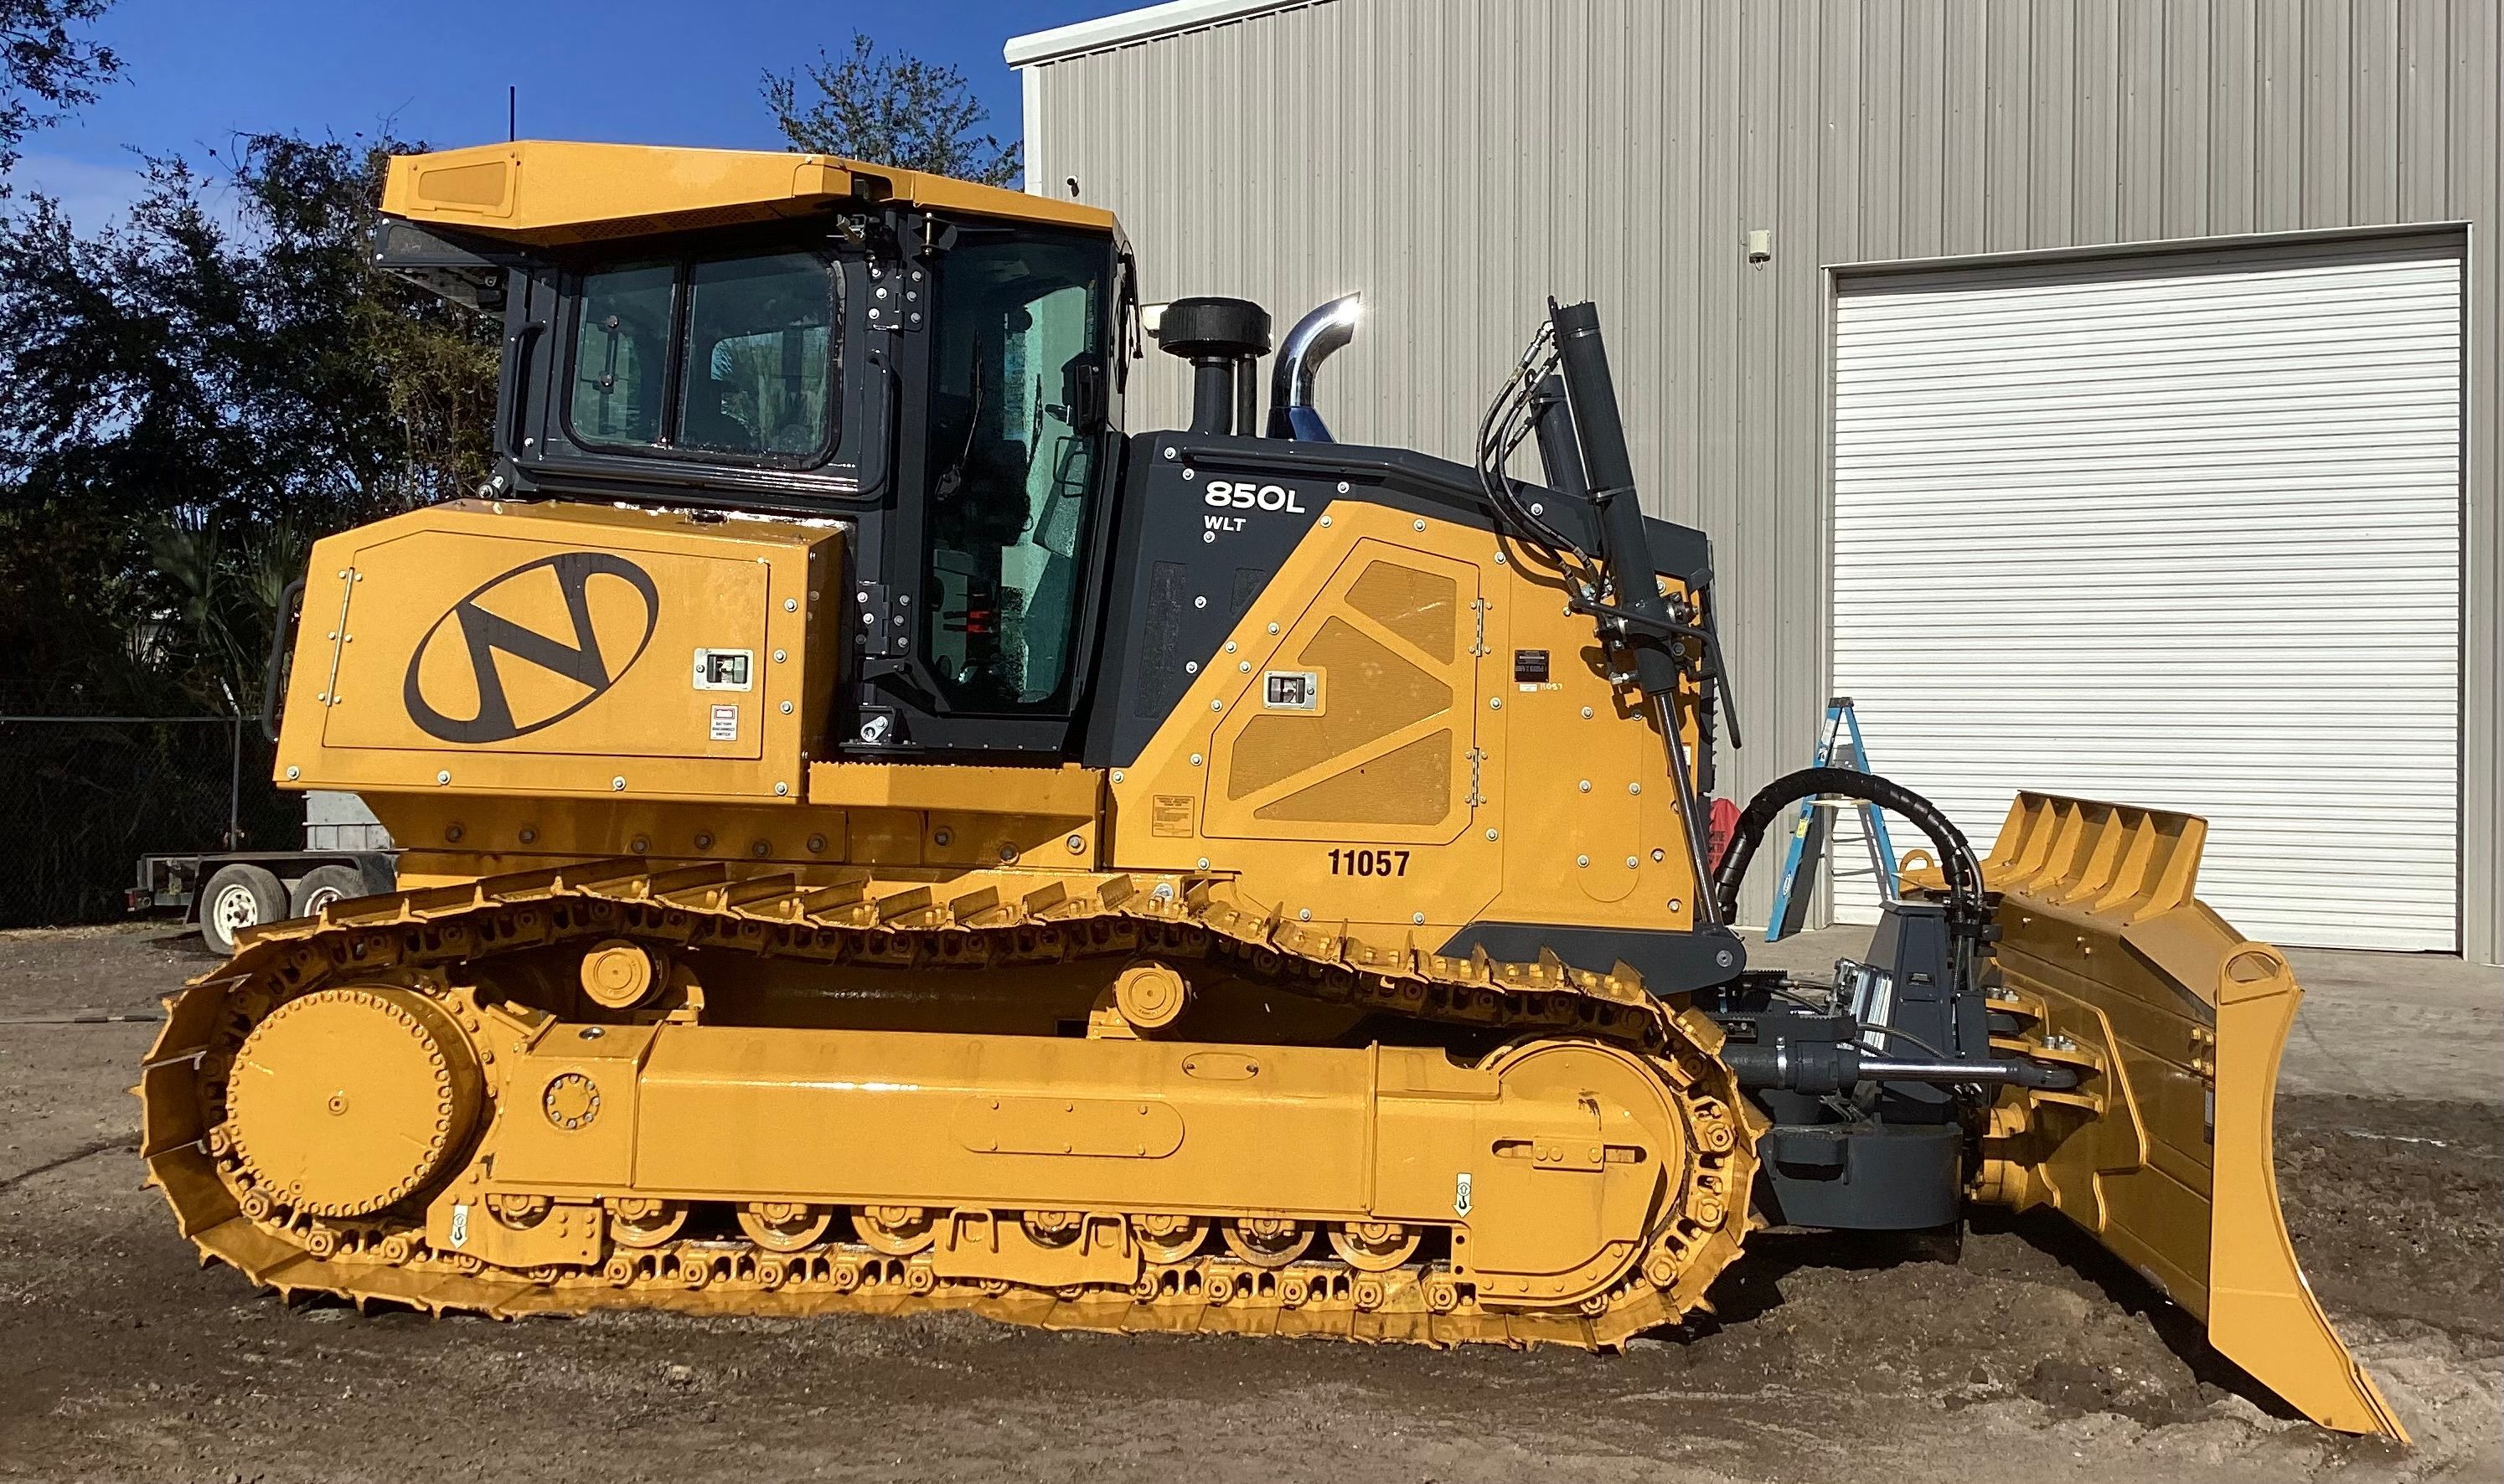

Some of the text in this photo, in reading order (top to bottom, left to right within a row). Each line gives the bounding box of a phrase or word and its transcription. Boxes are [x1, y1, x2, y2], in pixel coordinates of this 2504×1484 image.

[1204, 480, 1306, 514] 850L
[1204, 514, 1247, 532] WLT
[1328, 848, 1410, 877] 11057
